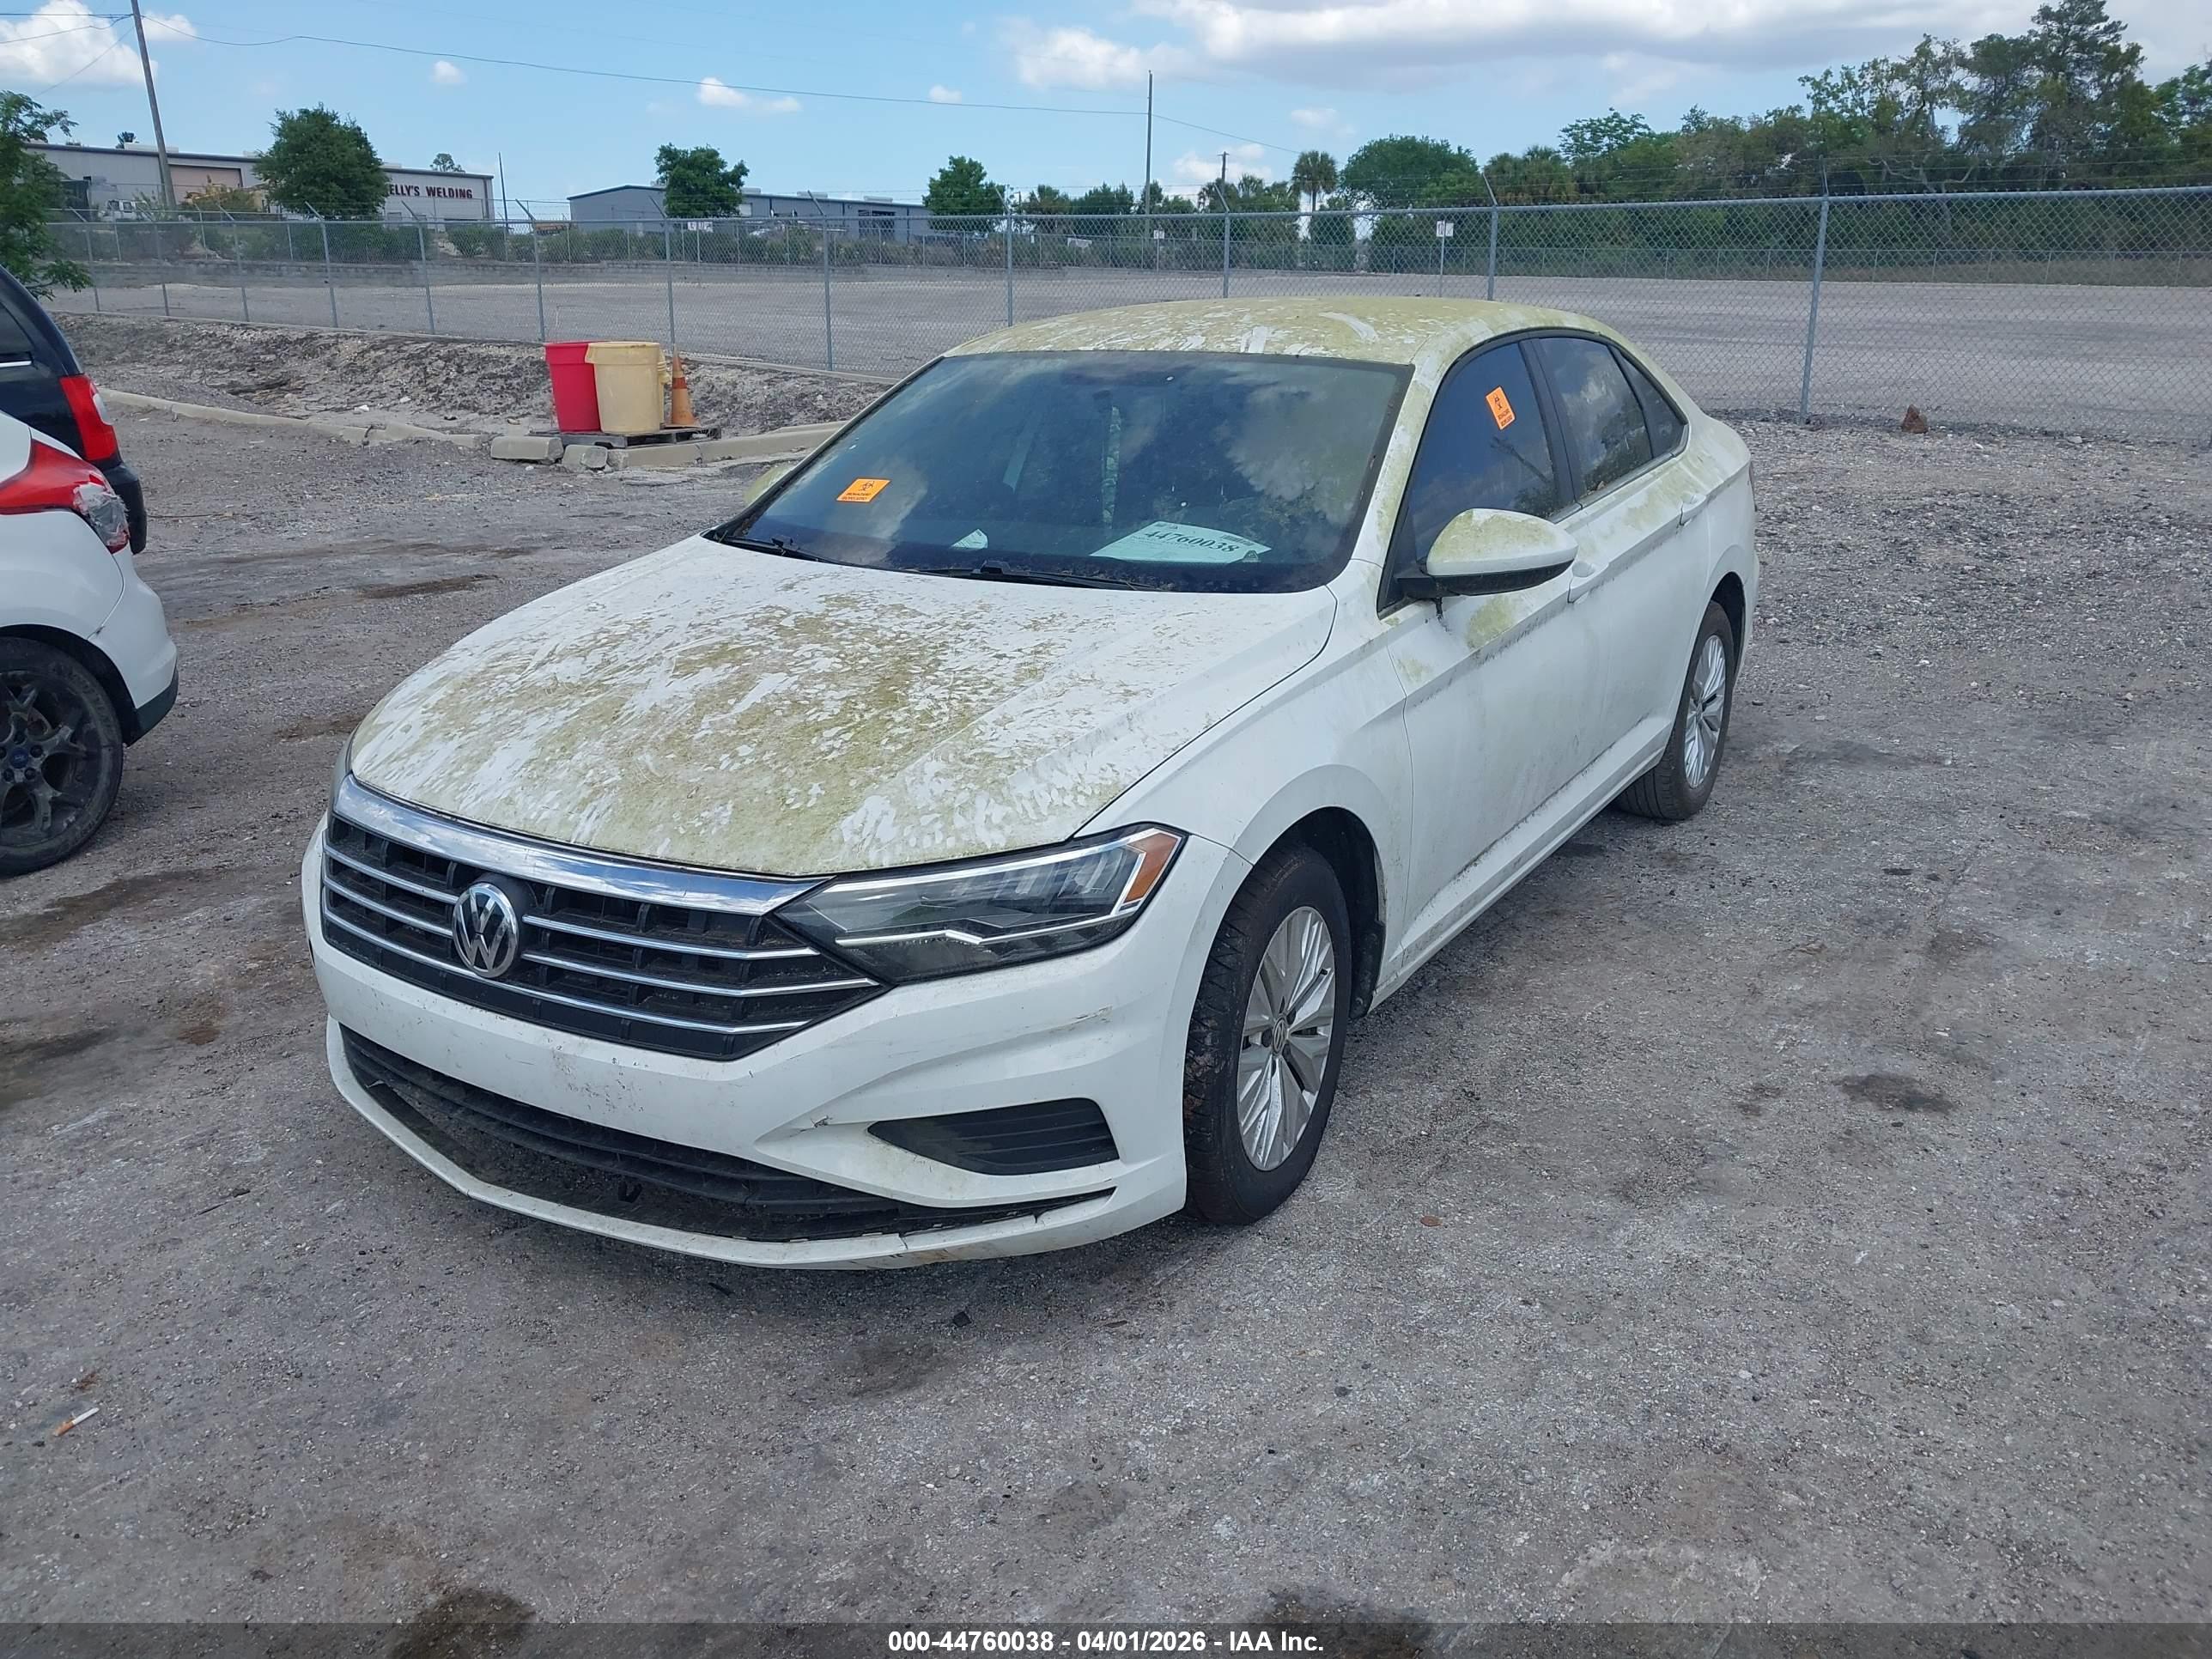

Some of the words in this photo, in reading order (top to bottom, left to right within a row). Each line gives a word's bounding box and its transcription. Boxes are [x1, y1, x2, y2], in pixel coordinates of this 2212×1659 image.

[386, 184, 420, 197] ELLY'S
[426, 185, 472, 198] WELDING
[1145, 531, 1239, 552] 44760038
